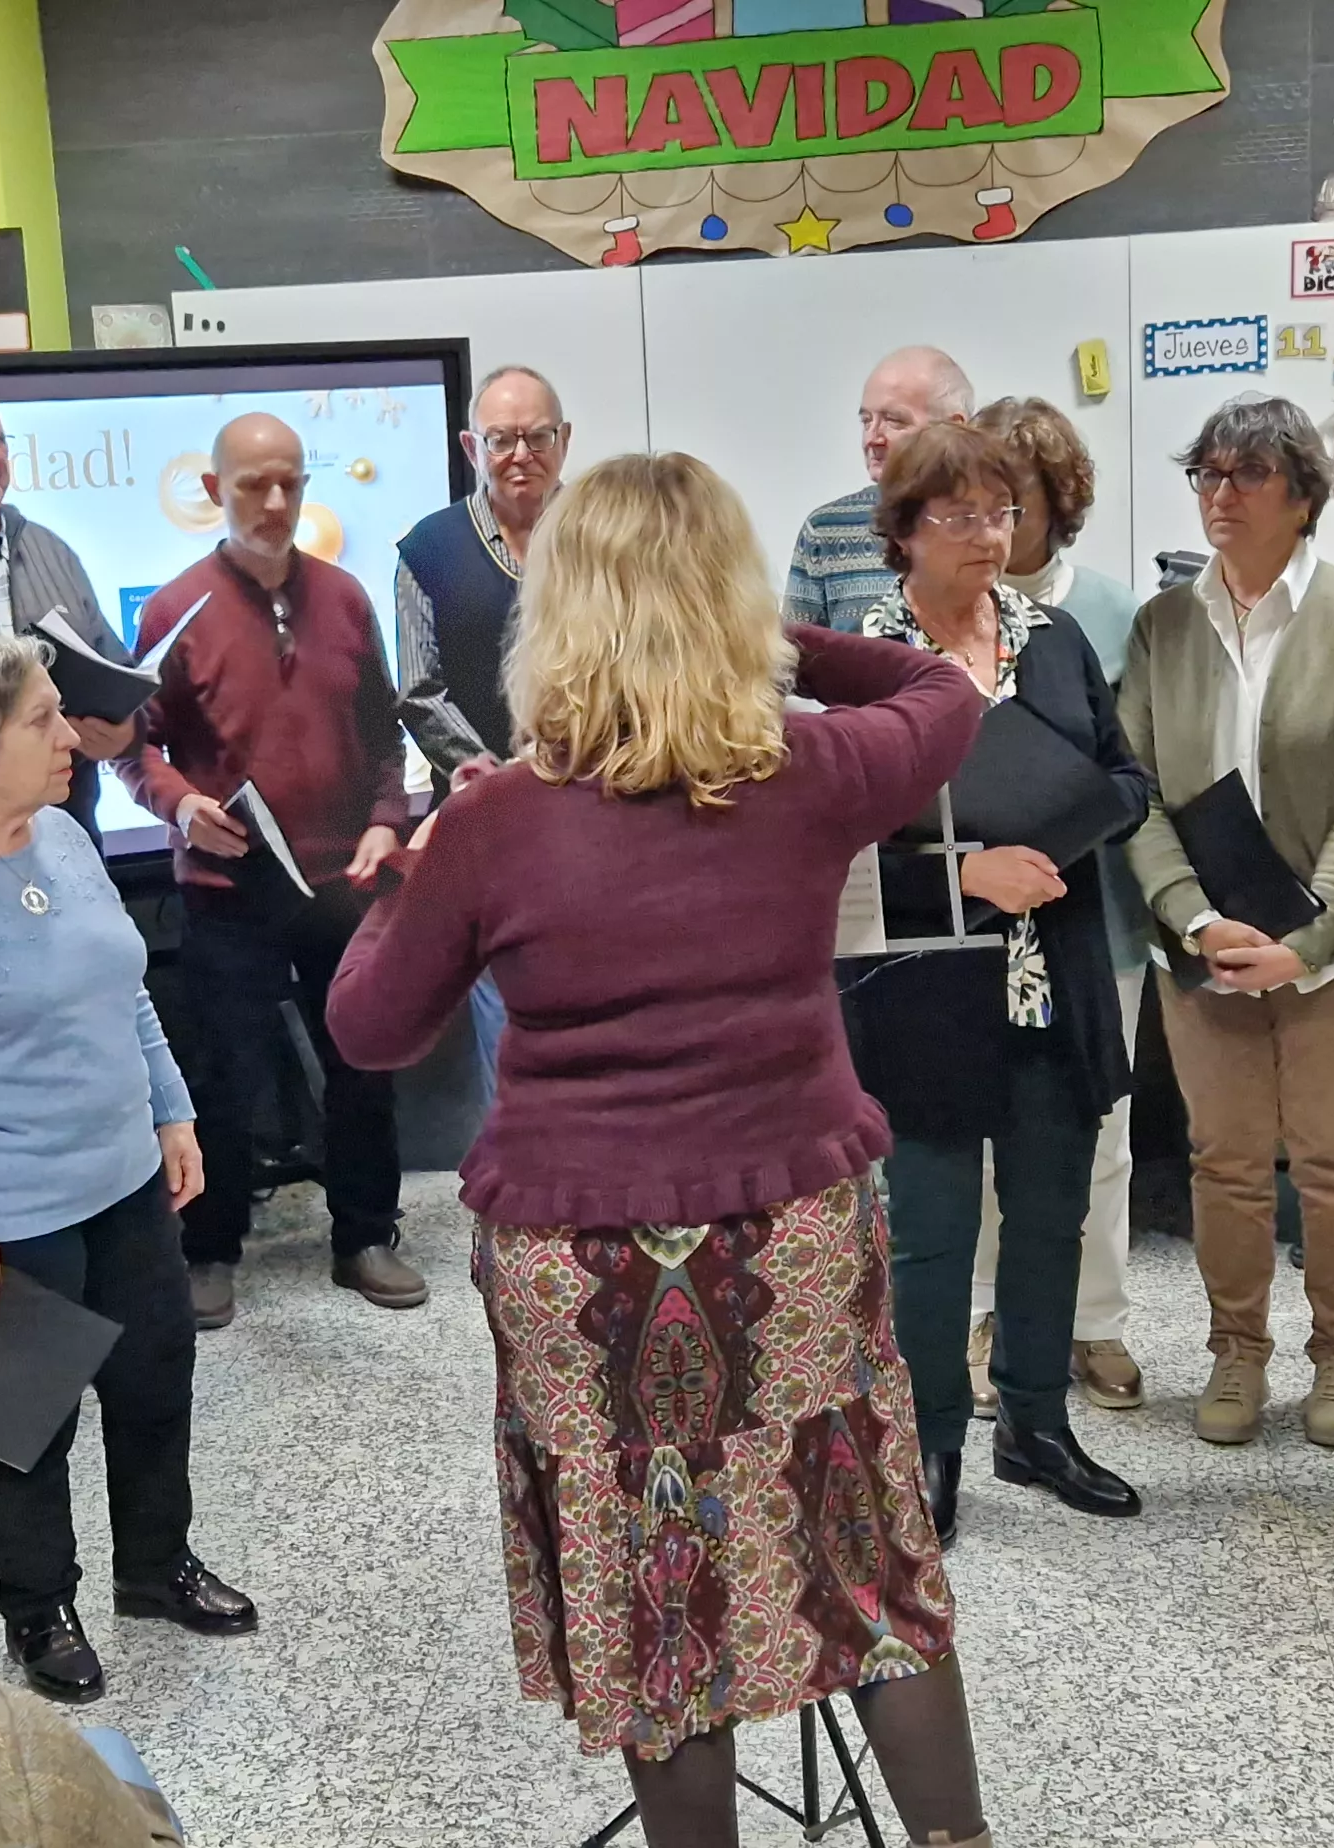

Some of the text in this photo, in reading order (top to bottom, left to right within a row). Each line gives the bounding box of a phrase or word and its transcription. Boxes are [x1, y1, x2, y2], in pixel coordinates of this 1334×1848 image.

[534, 43, 1082, 163] NAVIDAD
[1164, 332, 1249, 360] Jueves
[1277, 326, 1327, 357] 11
